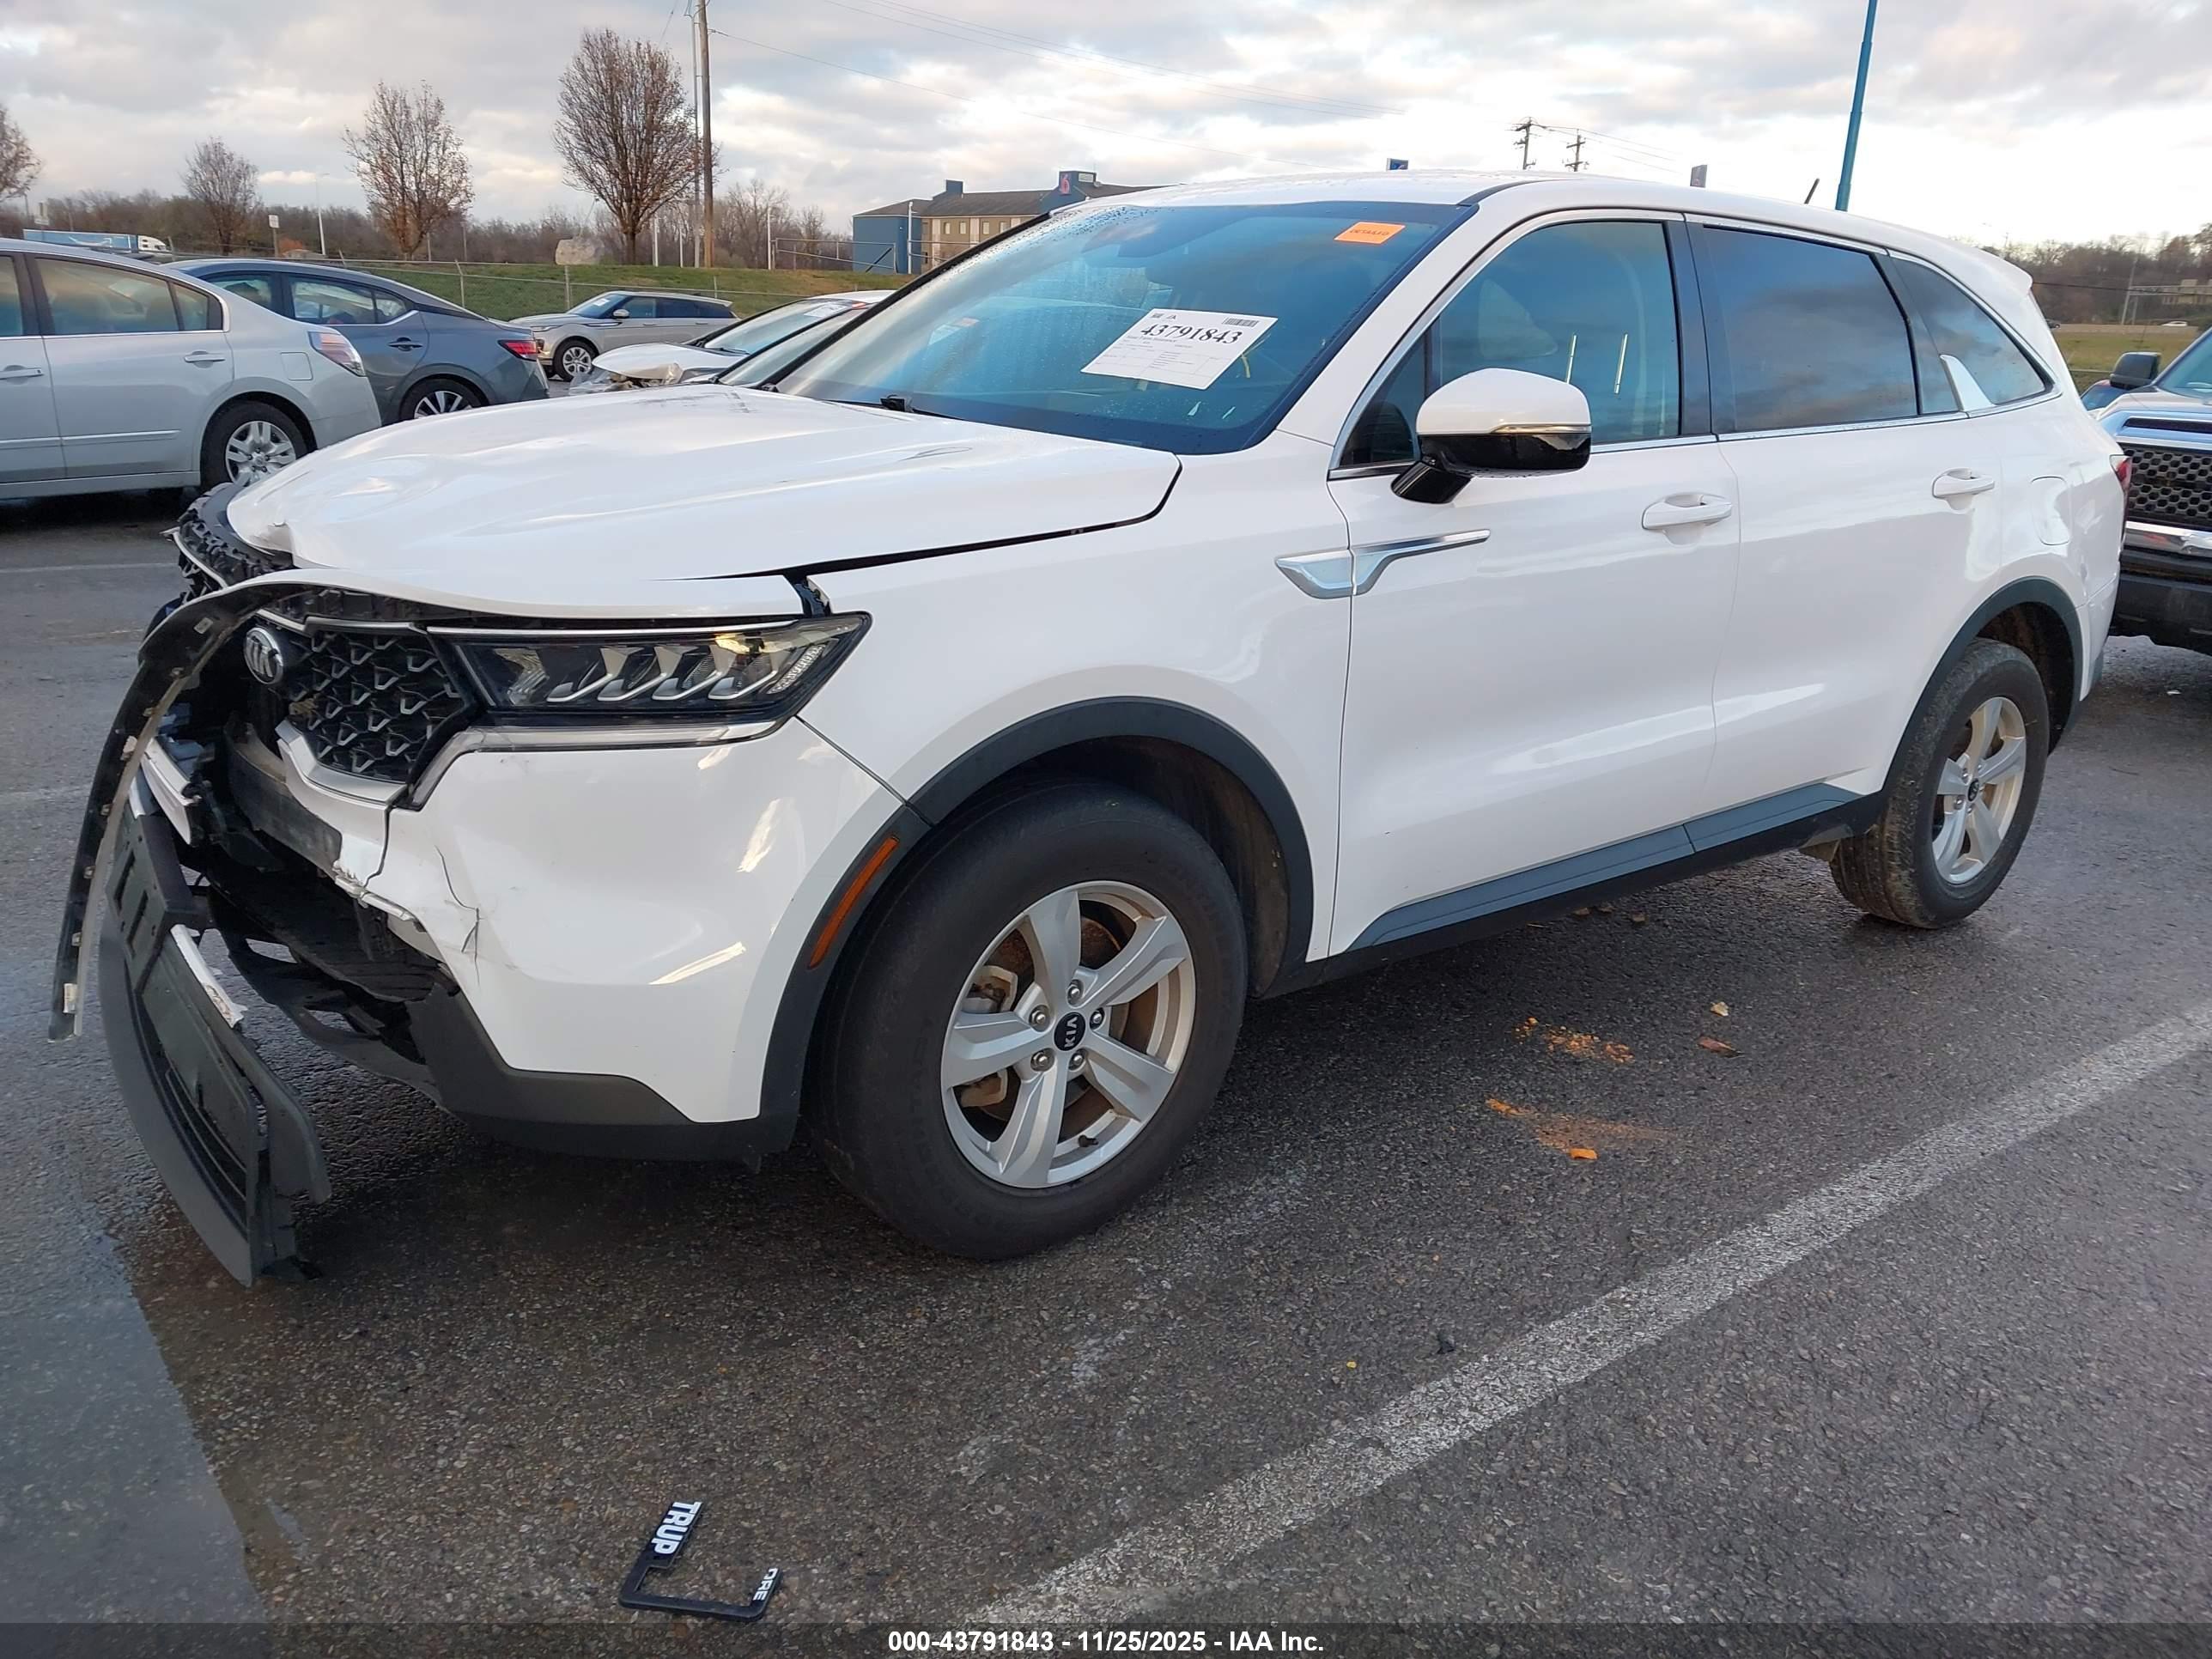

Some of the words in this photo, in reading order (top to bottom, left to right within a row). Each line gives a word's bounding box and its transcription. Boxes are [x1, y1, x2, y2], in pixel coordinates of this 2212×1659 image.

[1140, 323, 1243, 344] 43791843
[1064, 1016, 1079, 1048] KIA
[651, 1501, 702, 1554] TRUP
